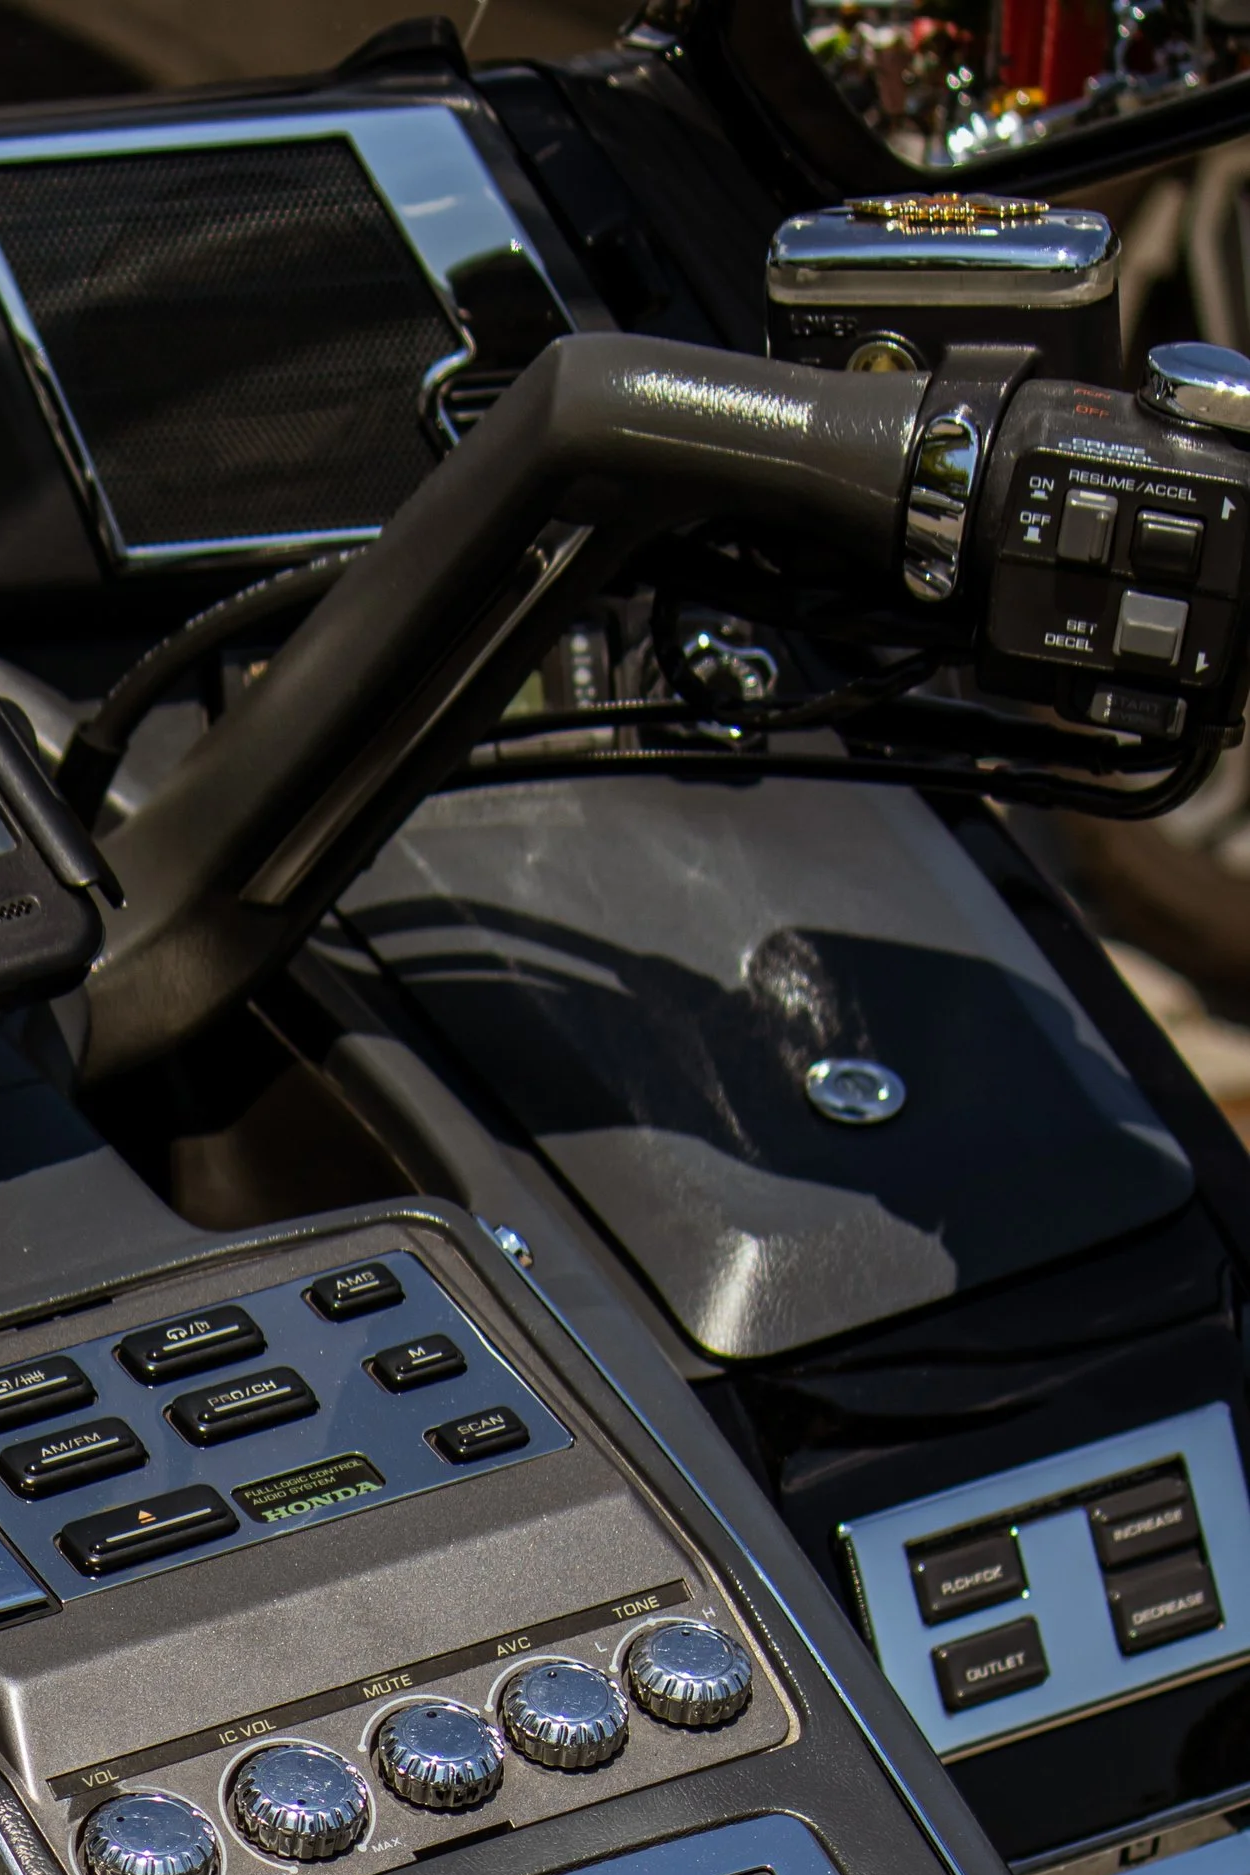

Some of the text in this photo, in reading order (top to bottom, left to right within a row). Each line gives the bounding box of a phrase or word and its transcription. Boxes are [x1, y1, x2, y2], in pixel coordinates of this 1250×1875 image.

[1075, 404, 1111, 419] OFF
[1029, 475, 1055, 492] ON
[1068, 468, 1197, 503] RESUME/ACCEL
[1019, 510, 1052, 527] OFF
[1066, 619, 1098, 635] SET
[1044, 632, 1094, 653] DECEL
[336, 1271, 375, 1290] AMB
[407, 1346, 426, 1359] M
[457, 1414, 505, 1435] SCAN
[40, 1431, 101, 1458] AM/FM
[244, 1460, 362, 1499] FULL LOGIC CONTROL
[253, 1476, 337, 1506] AUDIO SYSTEM
[261, 1481, 383, 1523] HONDA
[1112, 1508, 1183, 1543] INCREASE
[612, 1595, 660, 1620] TONE
[702, 1606, 717, 1620] H
[1131, 1591, 1205, 1626] DECREASE
[497, 1636, 531, 1658] AVC
[965, 1652, 1026, 1683] OUTLET
[362, 1673, 413, 1699] MUTE
[218, 1718, 277, 1746] IC VOL
[81, 1768, 120, 1789] VOL
[371, 1835, 404, 1854] MAX
